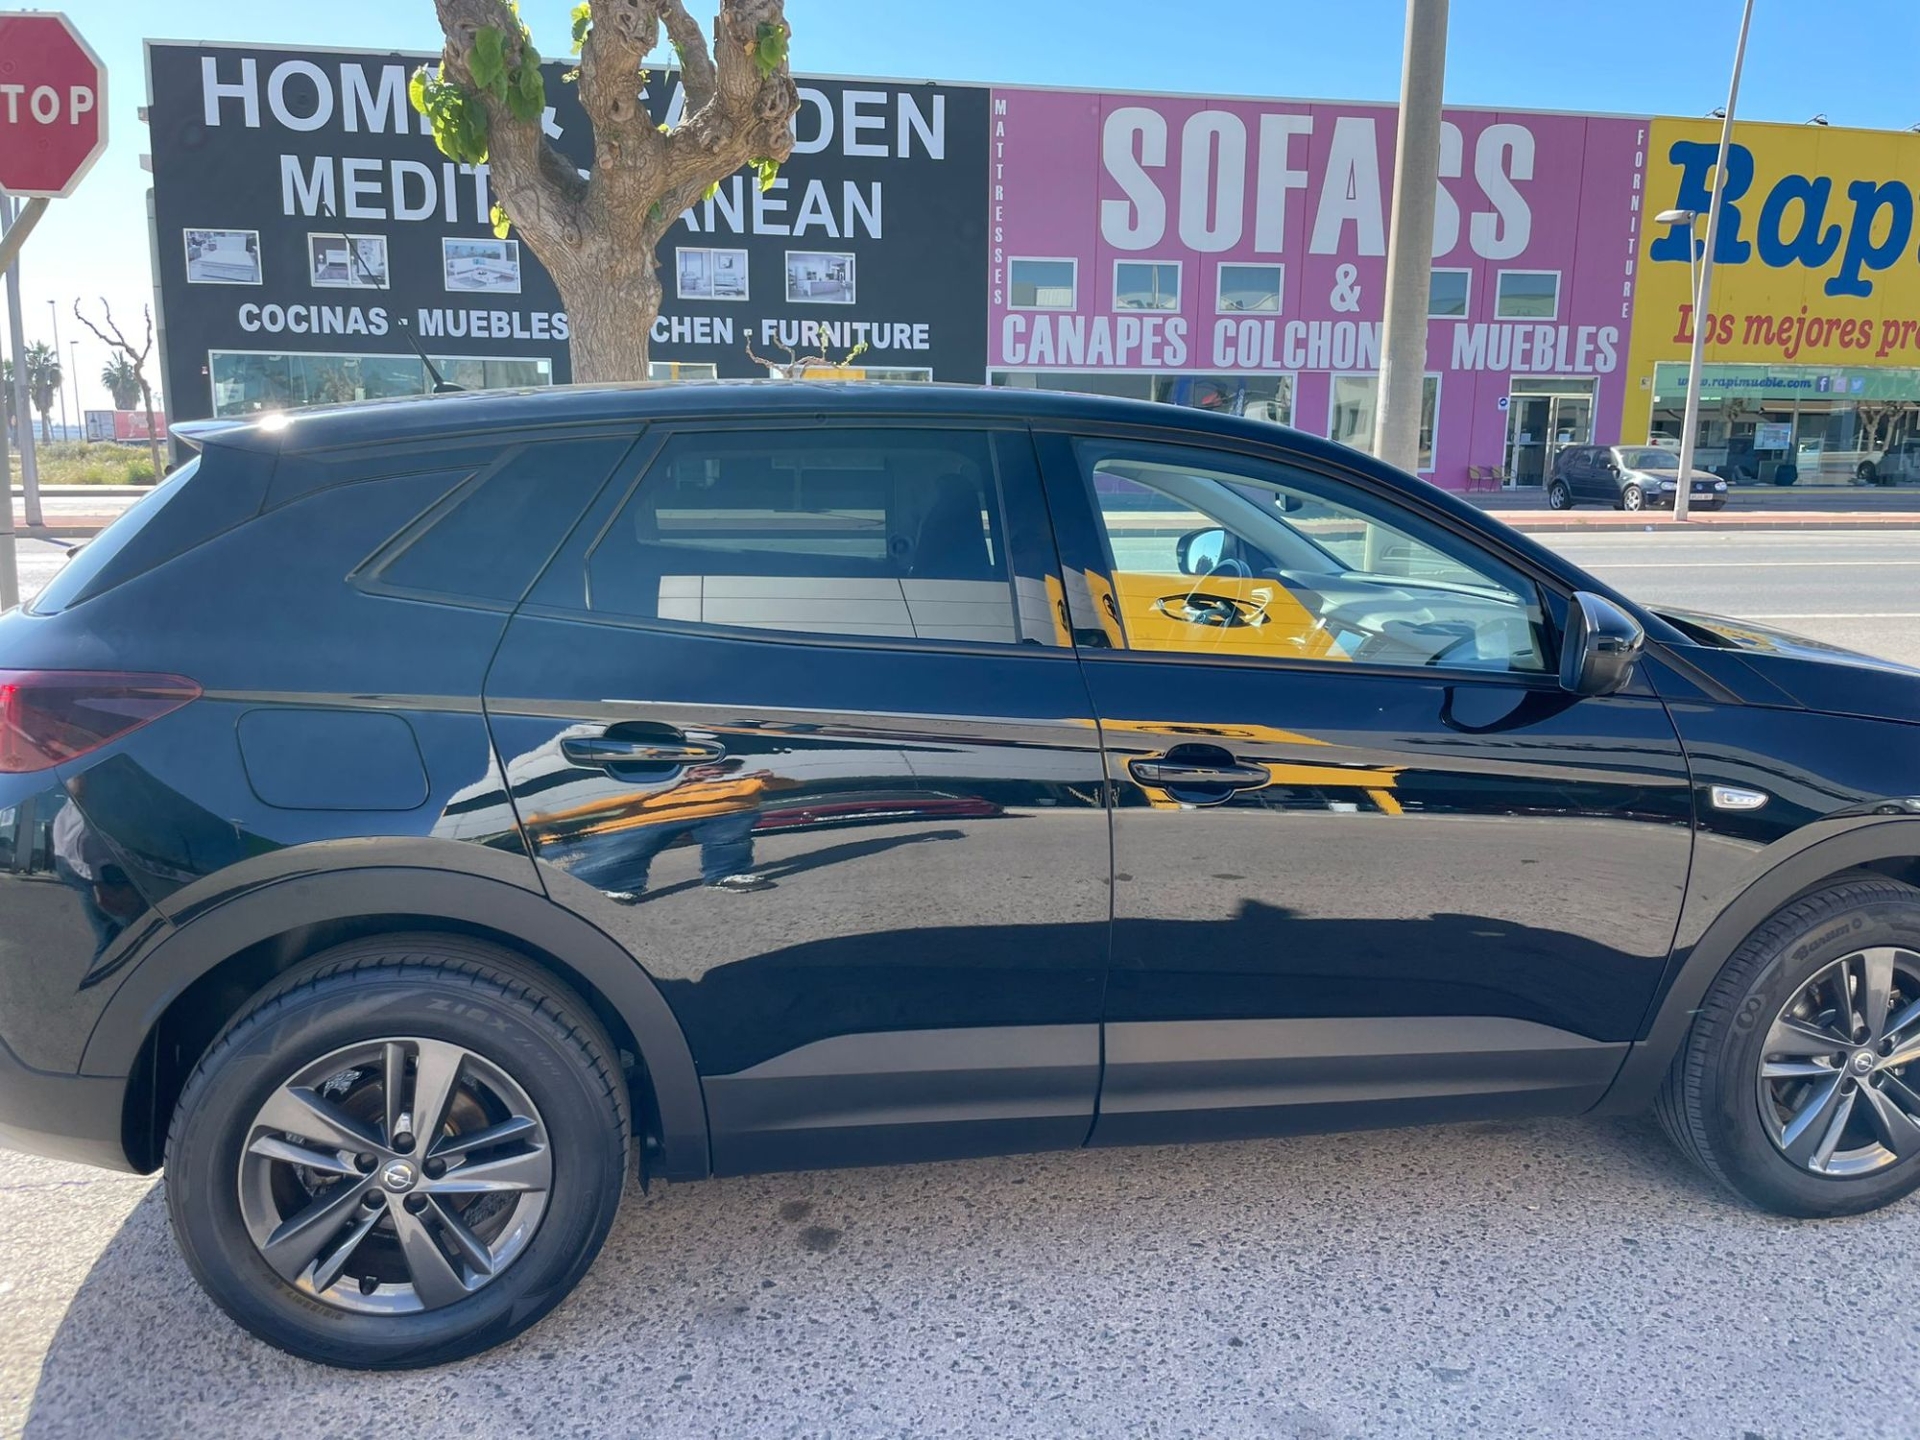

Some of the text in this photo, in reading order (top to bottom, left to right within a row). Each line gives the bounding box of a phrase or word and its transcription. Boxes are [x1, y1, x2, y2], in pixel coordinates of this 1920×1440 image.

[994, 99, 1007, 305] MATTRESSES
[1622, 129, 1645, 318] FORNITURE
[1650, 140, 1920, 298] Rap
[1330, 263, 1361, 312] &
[239, 303, 389, 336] COCINAS
[418, 309, 569, 340] MUEBLES
[761, 319, 930, 350] FURNITURE
[1002, 314, 1619, 373] CANAPES COLCHON MUEBLES
[1673, 304, 1920, 359] Los mejores pr
[1677, 376, 1812, 391] ww.rapimueble.com
